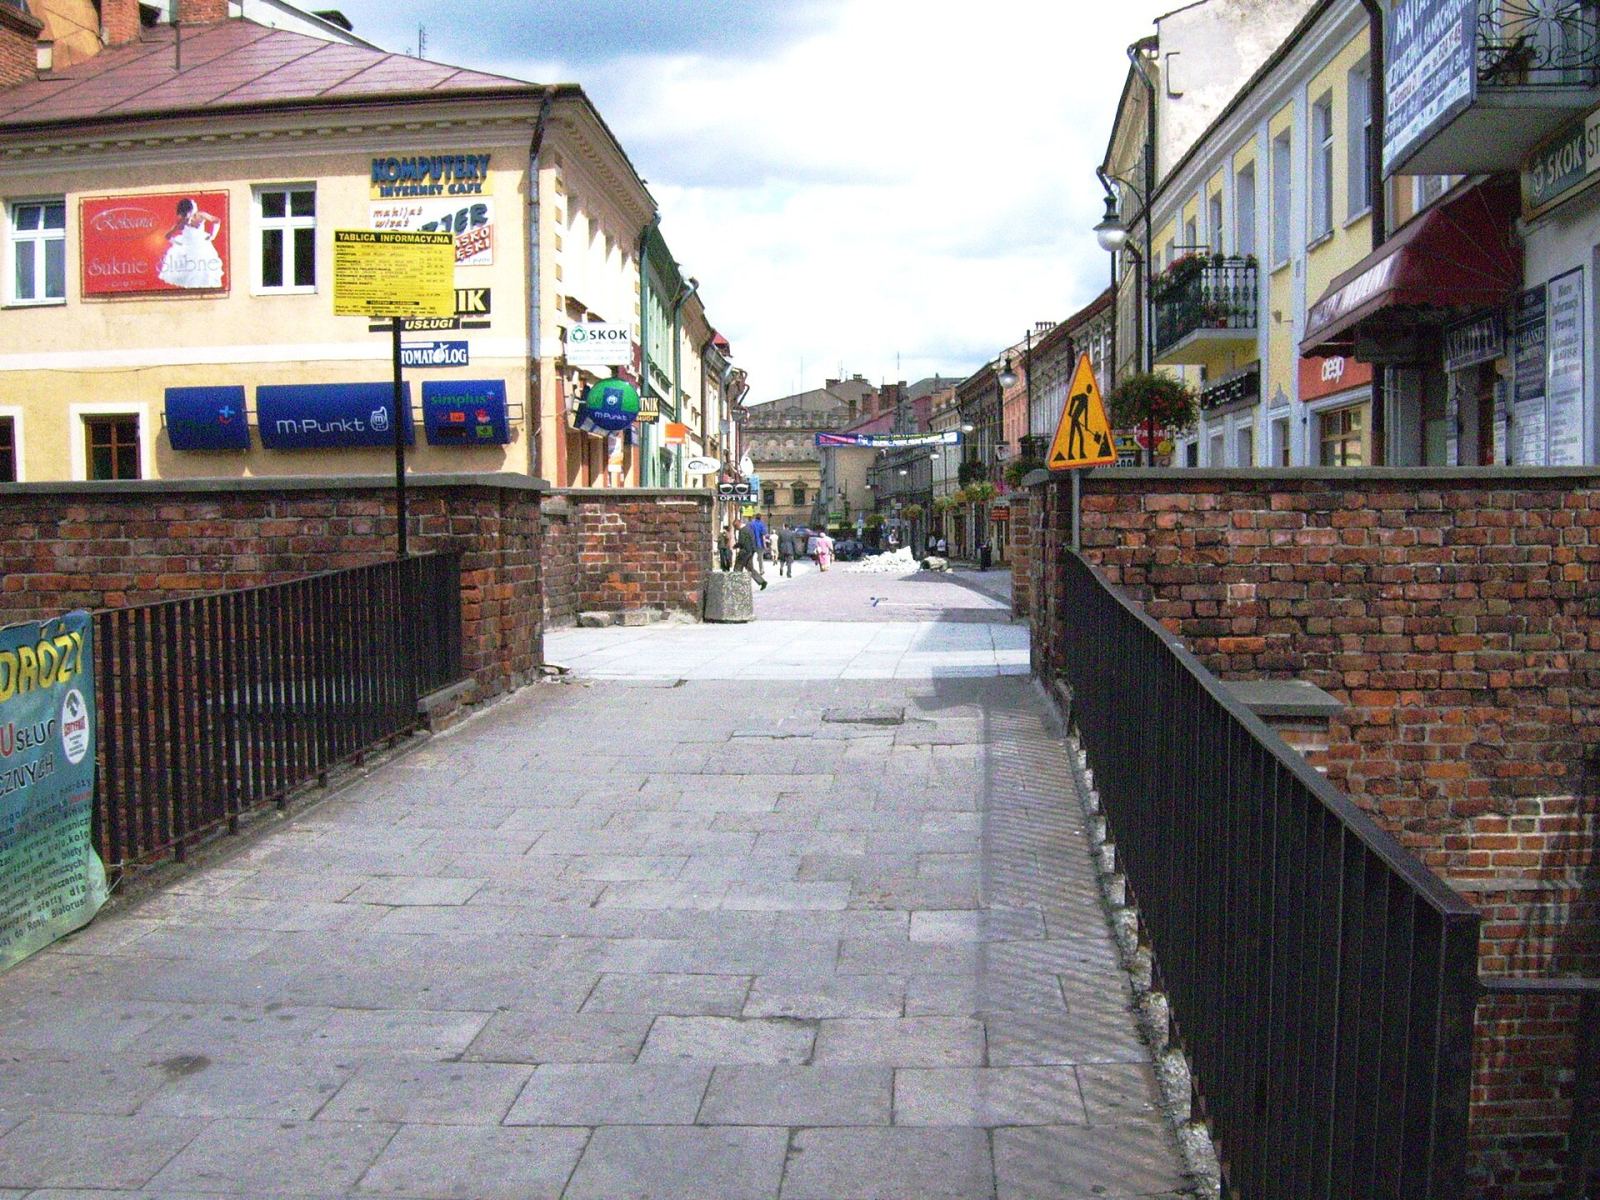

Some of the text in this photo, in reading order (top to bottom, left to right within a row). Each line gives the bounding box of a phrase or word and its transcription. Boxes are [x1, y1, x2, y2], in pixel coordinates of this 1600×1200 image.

[1547, 134, 1583, 185] SKOK
[371, 153, 491, 184] KOMPUTERY
[380, 182, 482, 197] INTERNET CAFE
[338, 232, 450, 244] TABLICA INFORMACYJNA
[88, 256, 148, 276] Suknie
[458, 289, 486, 312] IK
[404, 319, 454, 330] USŁUGI
[589, 329, 628, 340] SKOK
[400, 346, 467, 365] TOMATOLOG
[640, 397, 659, 412] TNIK
